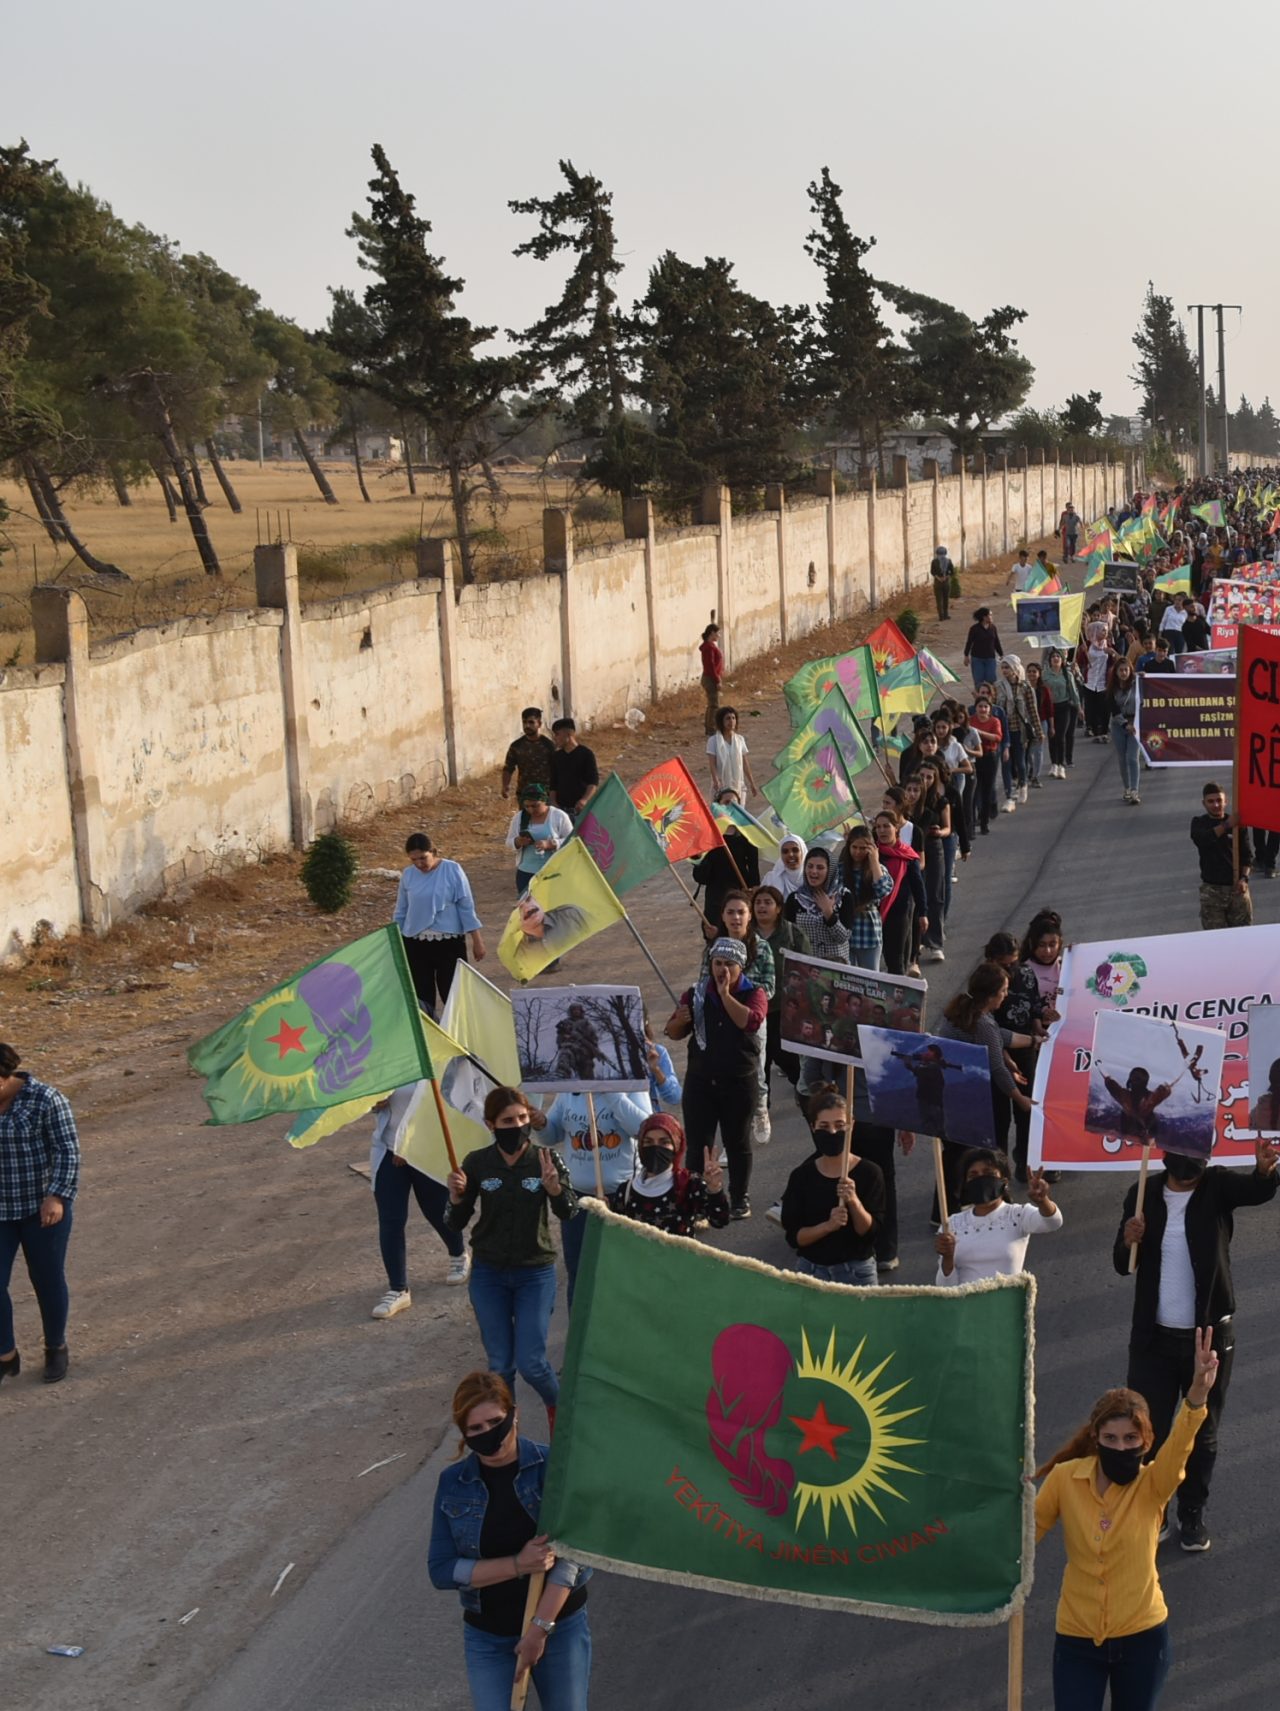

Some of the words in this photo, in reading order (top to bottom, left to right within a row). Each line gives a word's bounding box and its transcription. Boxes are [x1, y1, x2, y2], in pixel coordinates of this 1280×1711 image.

[1216, 626, 1235, 638] Riya
[1142, 699, 1150, 708] JI
[1152, 698, 1165, 707] BO
[1168, 697, 1225, 708] TOLHILDANA
[770, 1540, 850, 1566] JINÊN
[857, 1518, 950, 1564] CIWAN
